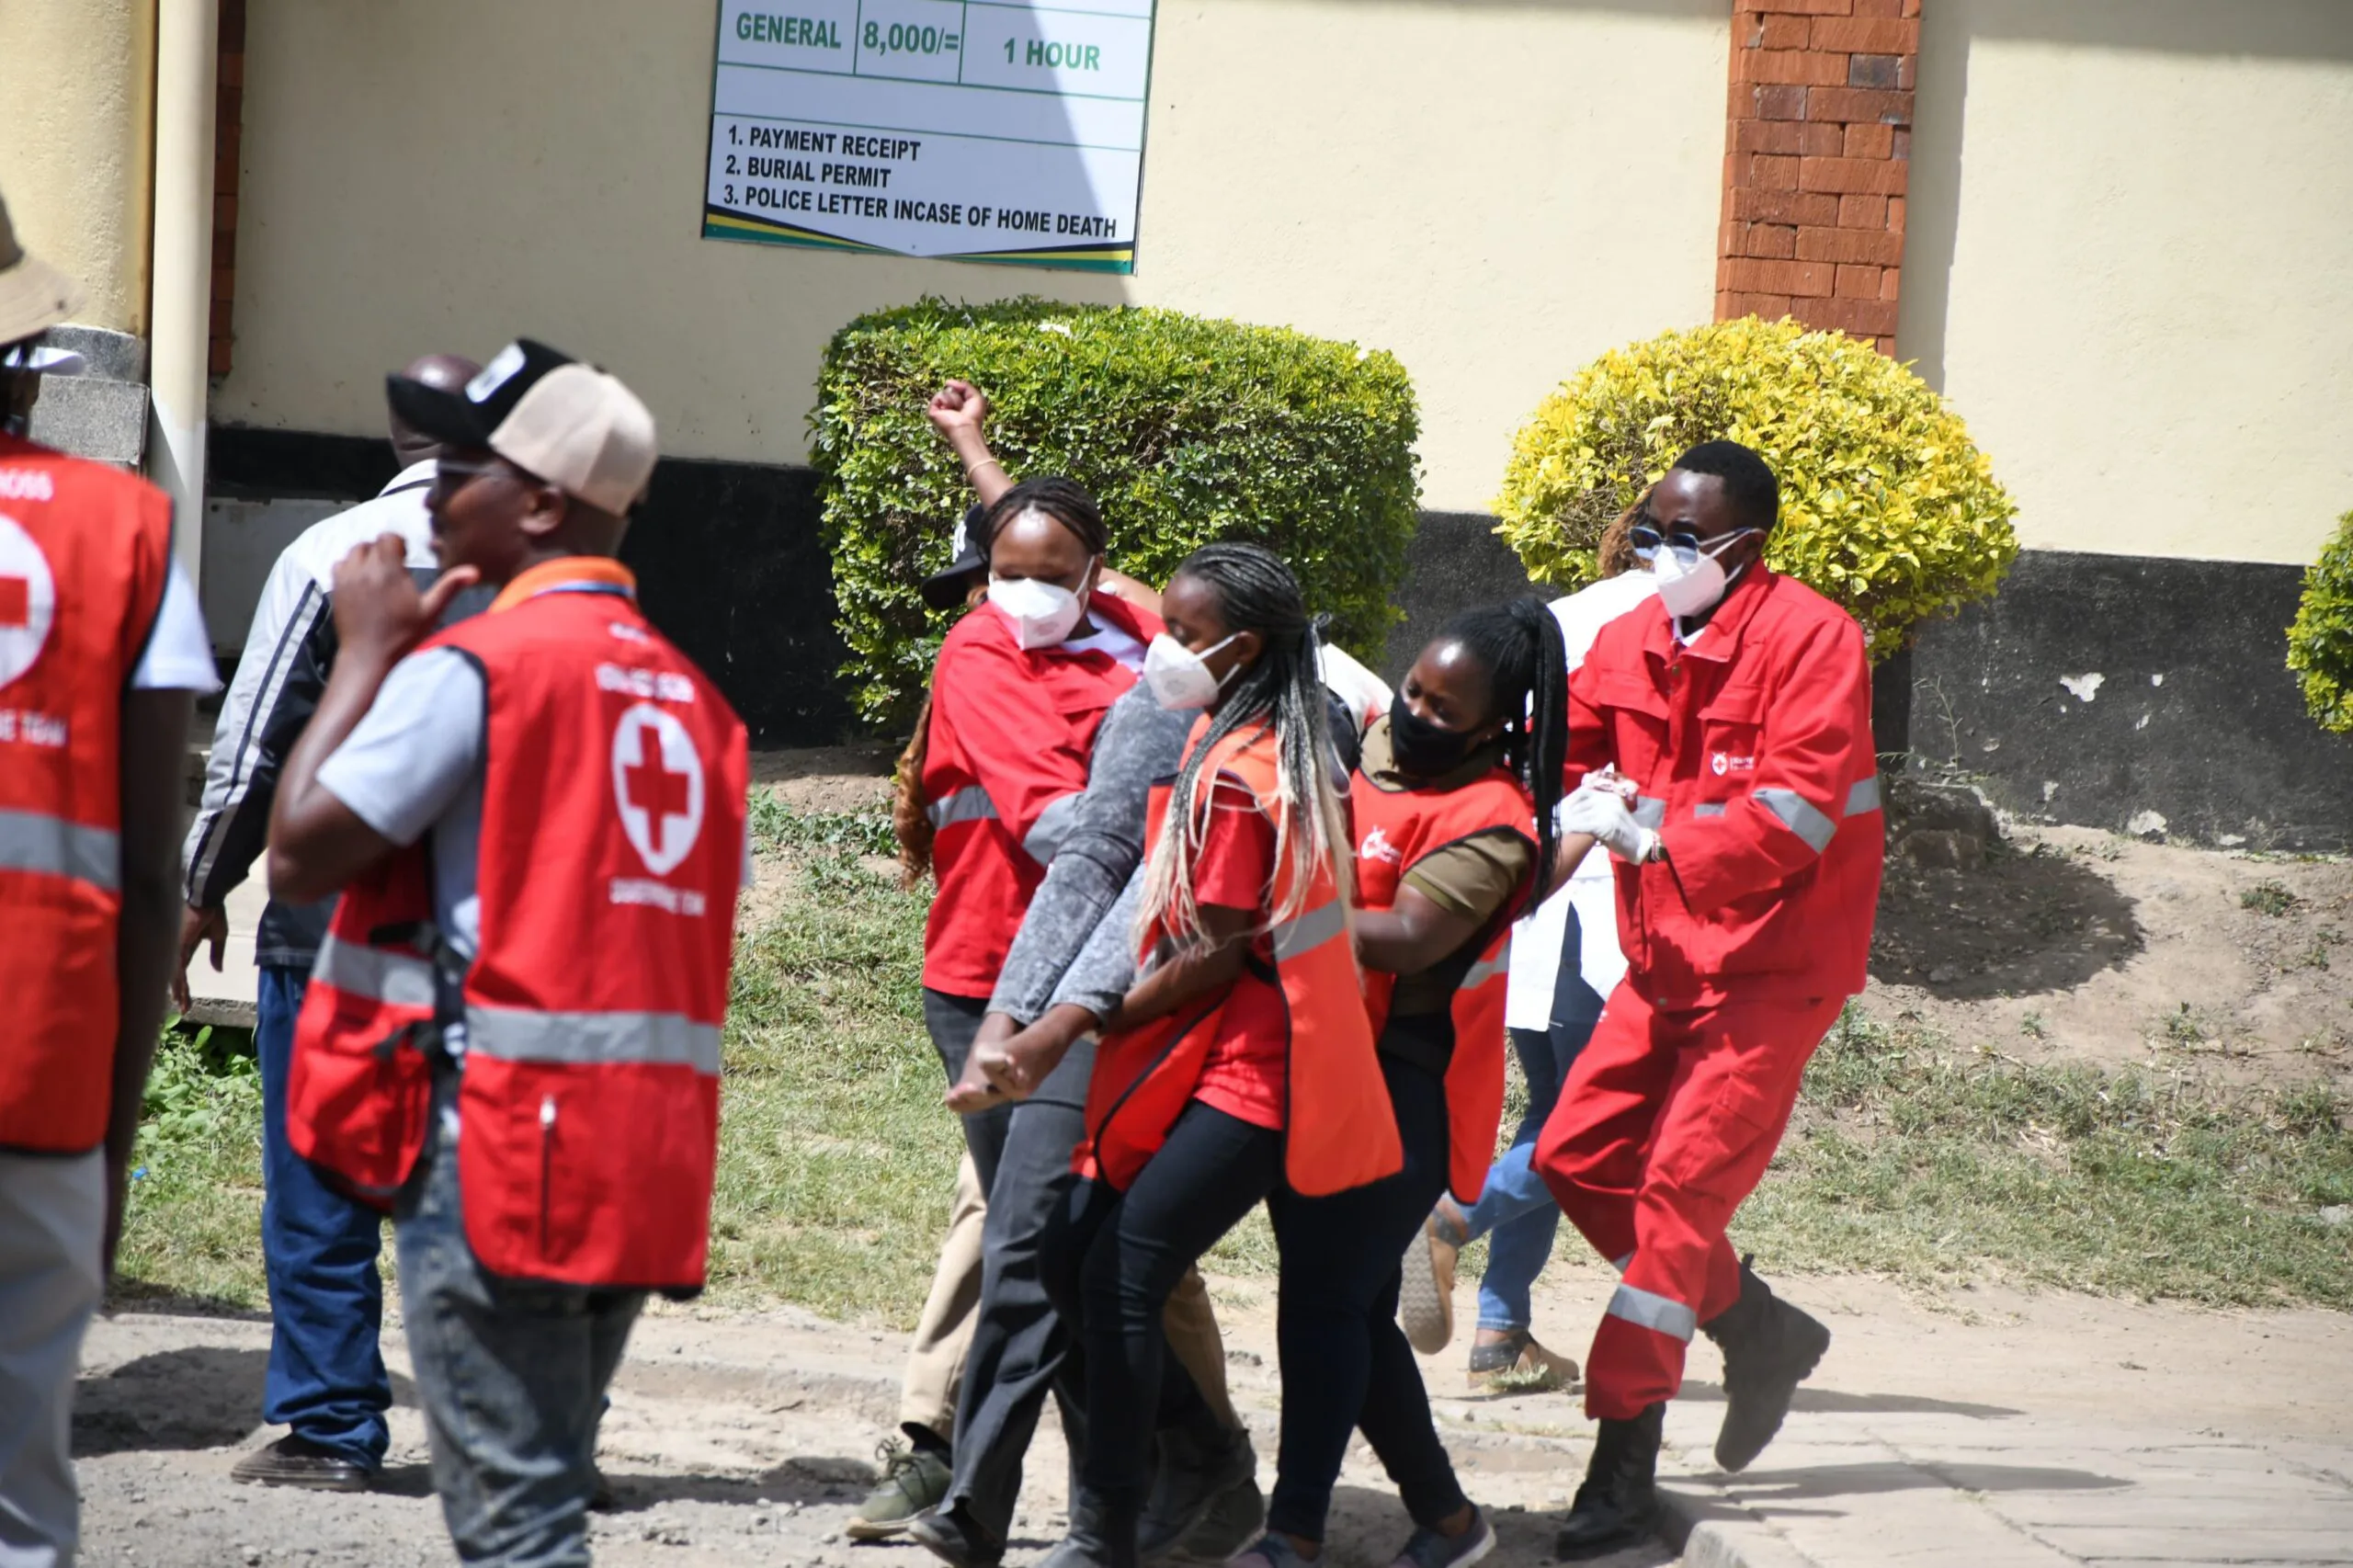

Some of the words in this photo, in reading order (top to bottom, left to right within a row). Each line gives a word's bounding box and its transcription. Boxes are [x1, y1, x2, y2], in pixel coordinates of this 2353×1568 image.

[736, 12, 842, 49] GENERAL
[863, 20, 959, 56] 8,000/=
[1004, 37, 1016, 64] 1
[1026, 39, 1100, 71] HOUR
[728, 124, 744, 146] 1.
[749, 126, 837, 153] PAYMENT
[842, 134, 921, 162] RECEIPT
[725, 153, 741, 176] 2.
[747, 155, 815, 182] BURIAL
[821, 163, 892, 188] PERMIT
[723, 184, 738, 205] 3.
[745, 186, 813, 211] POLICE
[817, 192, 888, 219] LETTER
[893, 199, 962, 225] INCASE
[967, 205, 992, 228] OF
[997, 208, 1051, 233] HOME
[1057, 213, 1117, 238] DEATH
